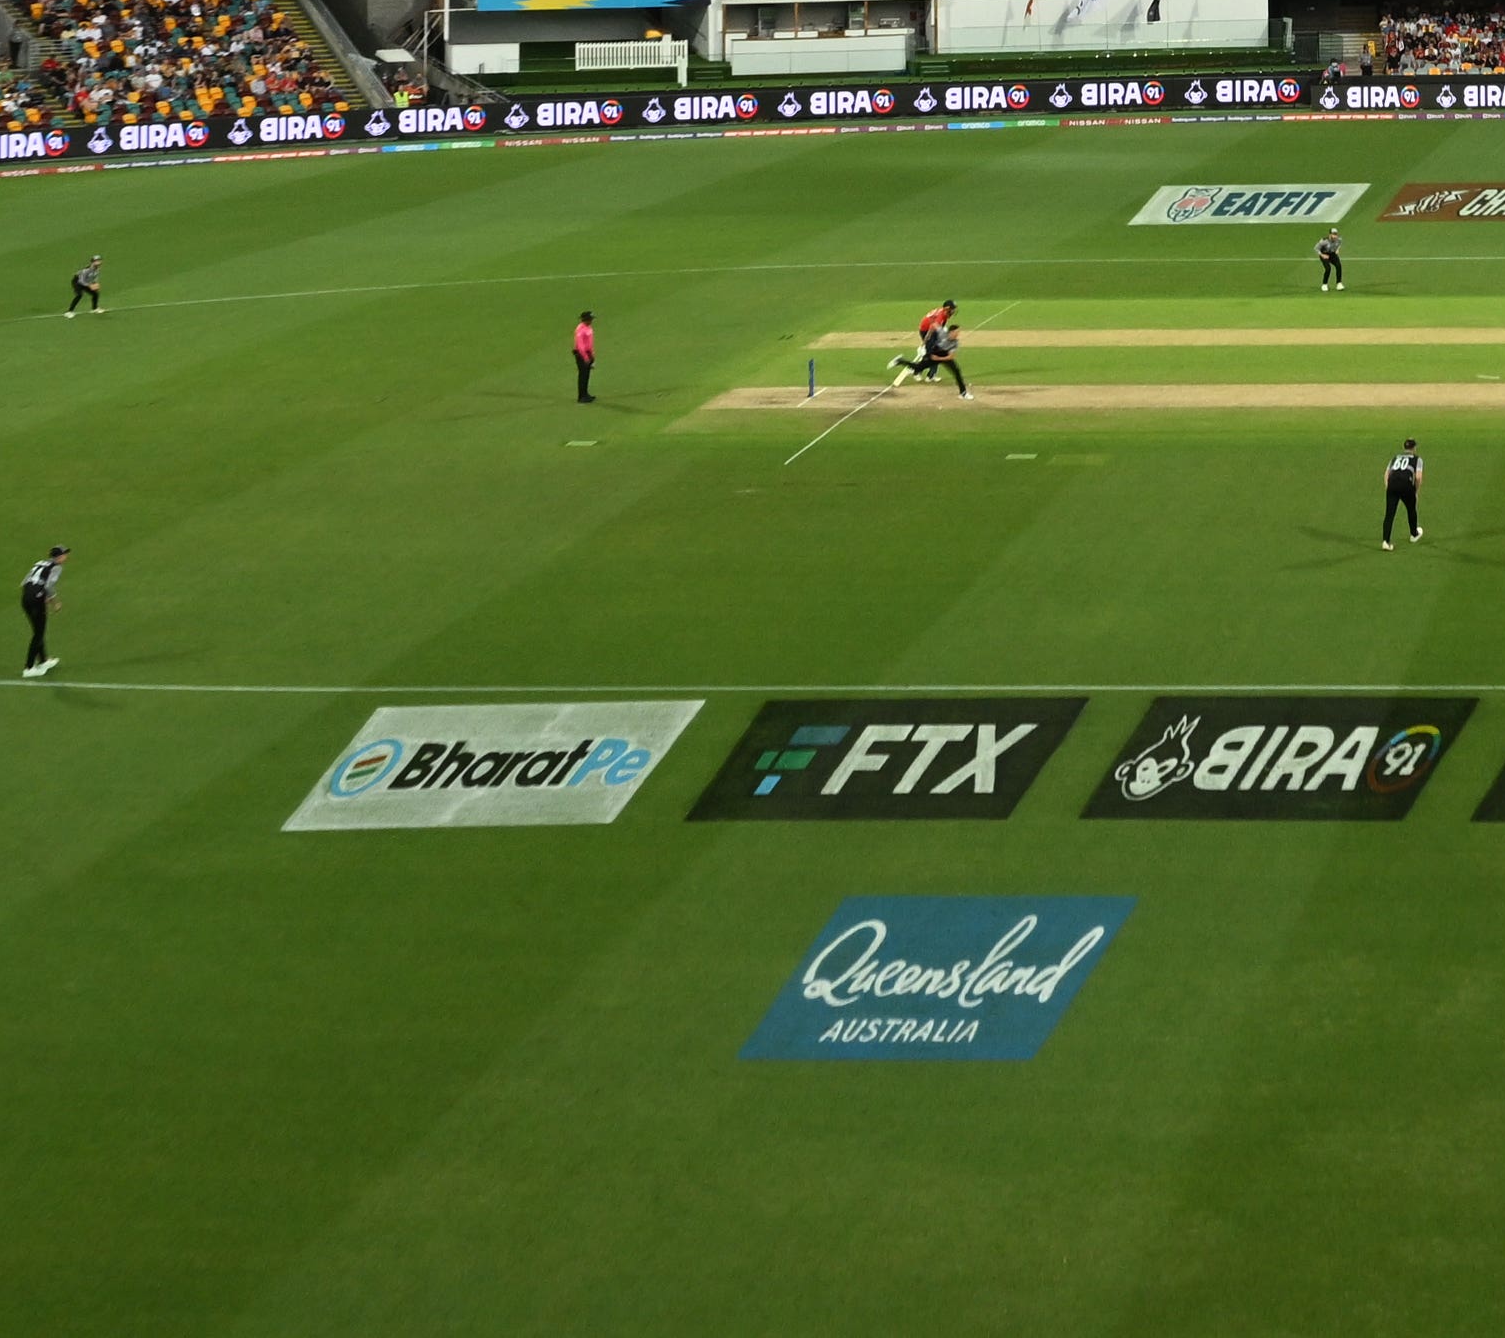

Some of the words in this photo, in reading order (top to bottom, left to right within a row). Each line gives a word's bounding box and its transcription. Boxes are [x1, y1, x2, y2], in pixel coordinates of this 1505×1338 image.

[810, 91, 872, 115] BIRA
[1081, 82, 1143, 105] BIRA
[1347, 86, 1401, 108] BIRA
[536, 101, 601, 126] BIRA
[119, 122, 186, 151] BIRA
[1212, 191, 1336, 218] EATFIT
[387, 738, 651, 791] BharatPe
[821, 724, 1039, 795] FTX
[1193, 725, 1381, 791] BIRA
[1382, 742, 1428, 777] 91
[802, 914, 1105, 1008] Queensland
[818, 1018, 981, 1044] AUSTRALIA
